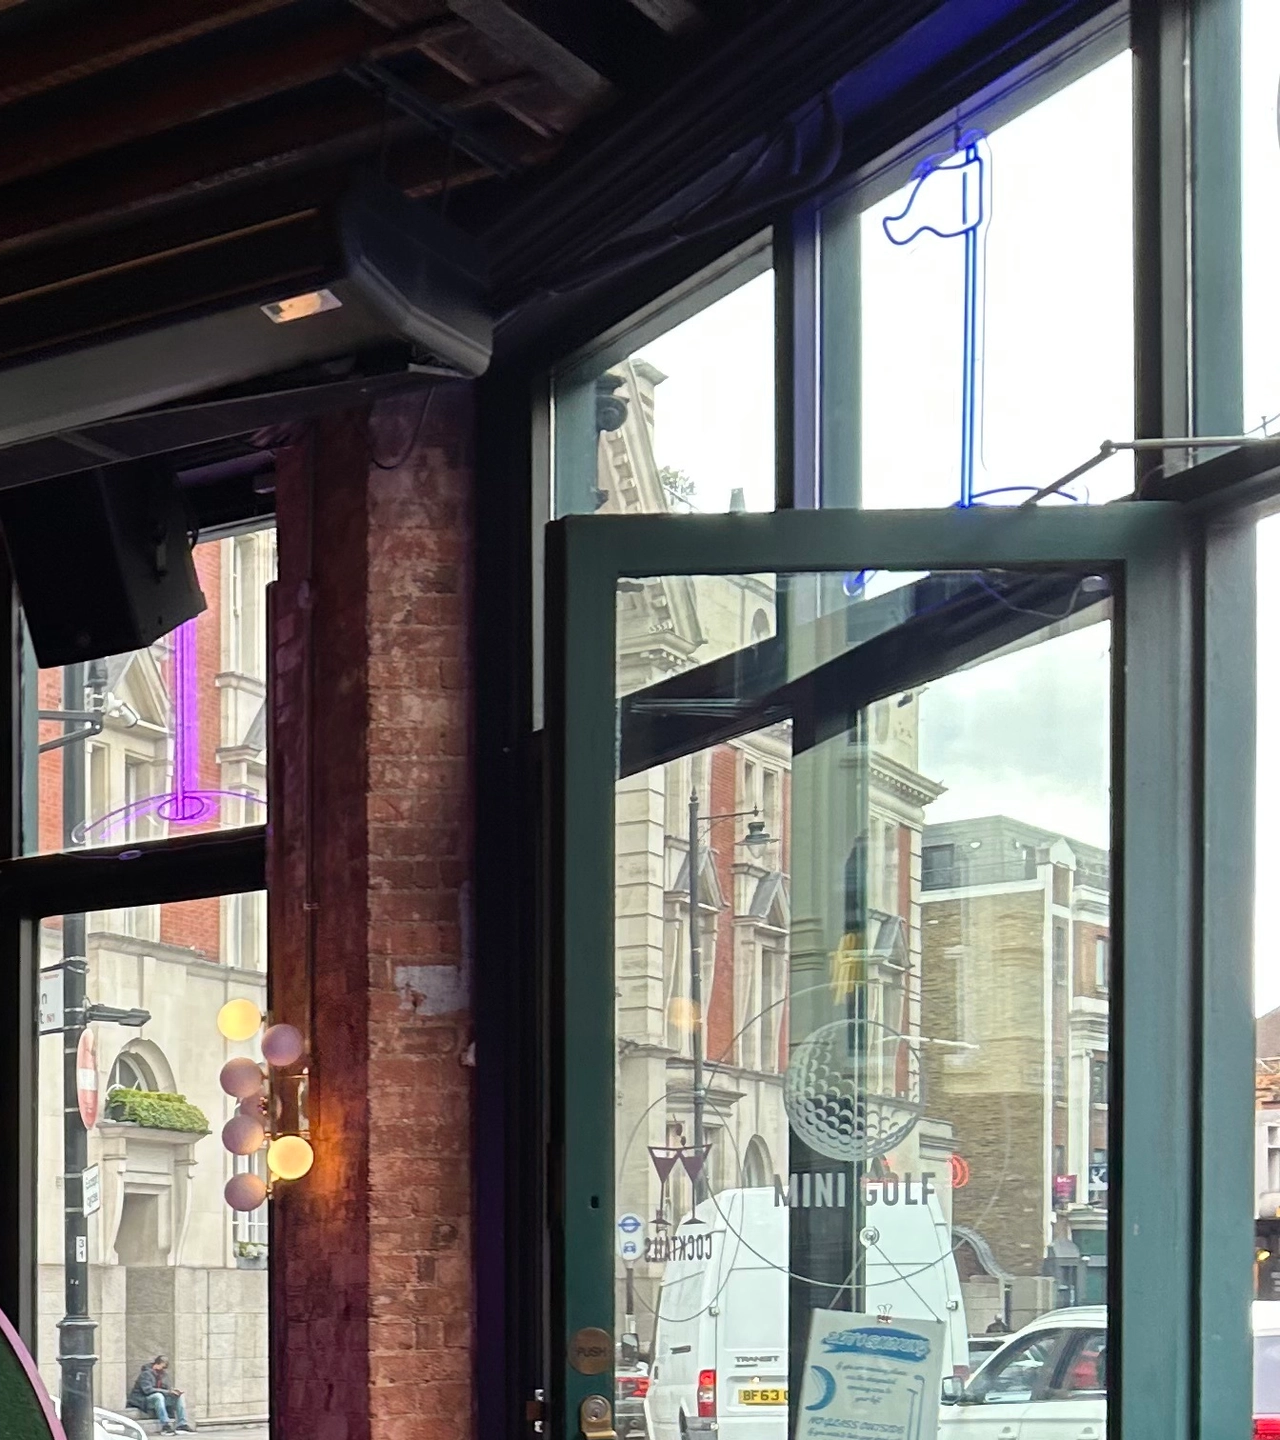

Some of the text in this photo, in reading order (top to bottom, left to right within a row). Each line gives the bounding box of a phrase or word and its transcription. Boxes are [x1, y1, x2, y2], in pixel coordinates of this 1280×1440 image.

[773, 1171, 936, 1208] MINI GOLF
[577, 1345, 607, 1358] PUSH
[734, 1355, 780, 1363] TRANSIT
[742, 1389, 780, 1402] BF63
